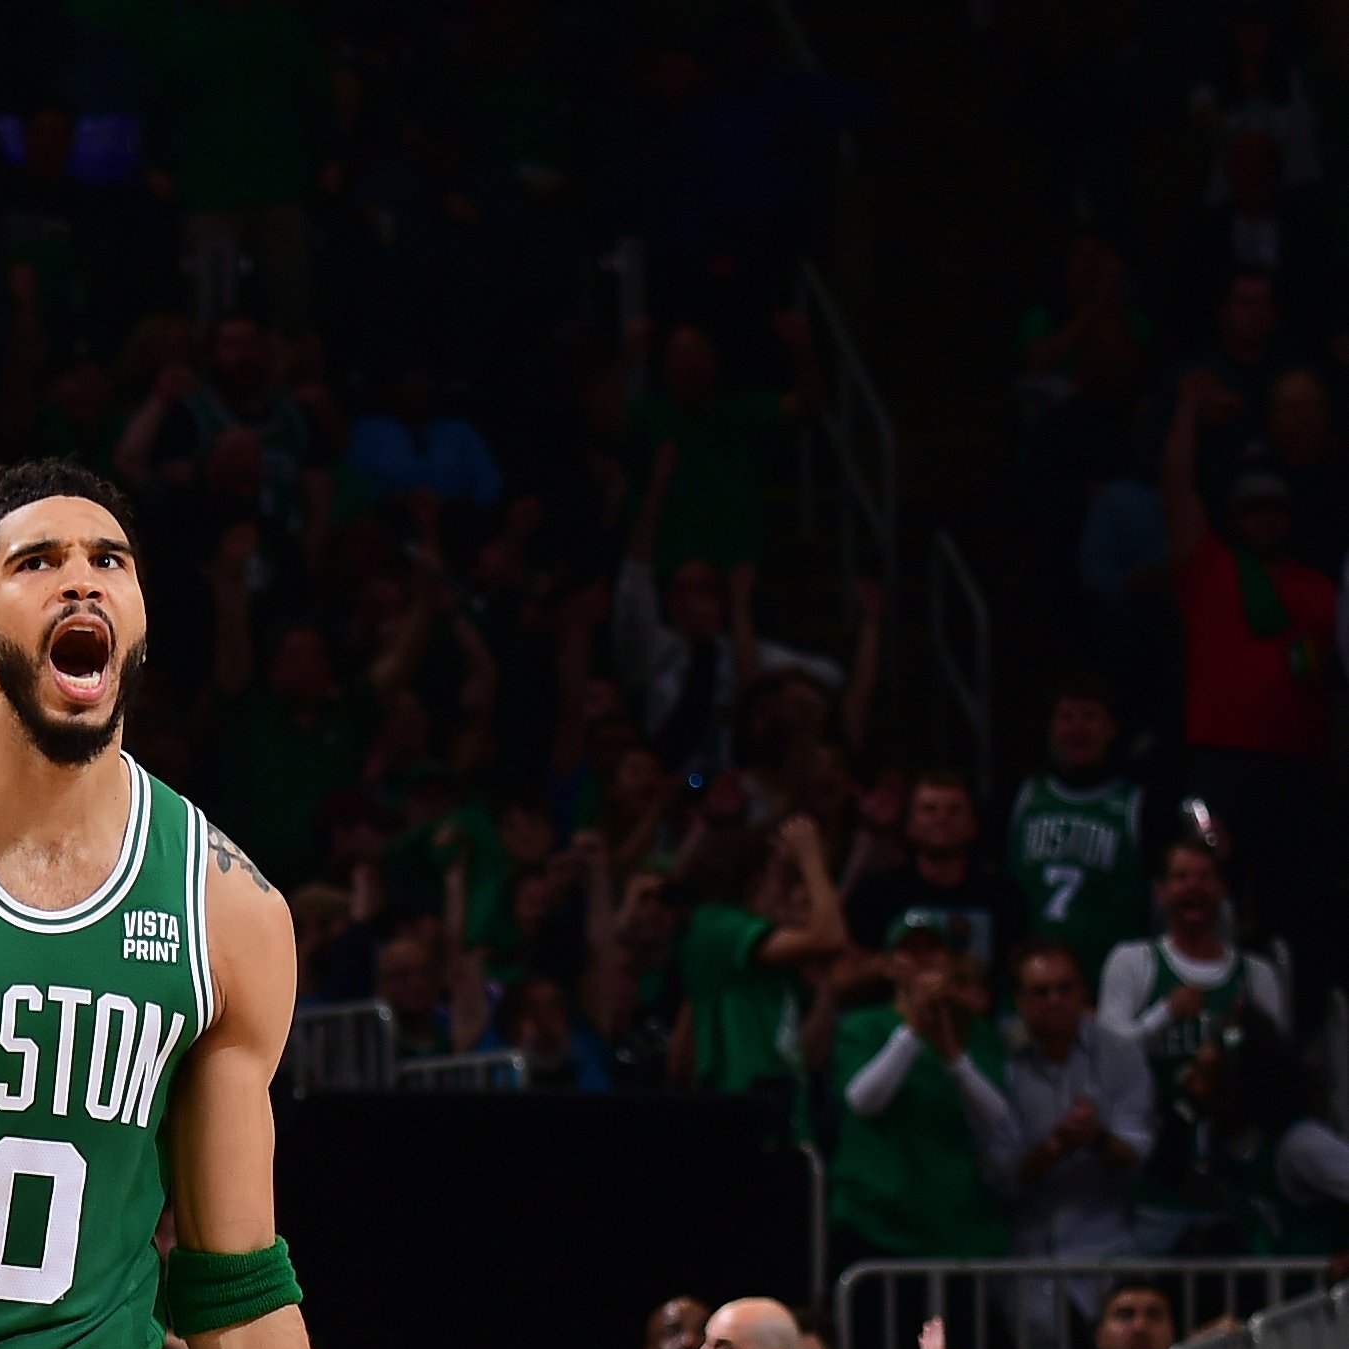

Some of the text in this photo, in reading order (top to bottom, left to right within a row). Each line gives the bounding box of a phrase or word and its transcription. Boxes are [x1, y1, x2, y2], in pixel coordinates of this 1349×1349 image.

[1042, 862, 1085, 922] 7
[123, 910, 180, 944] VISTA
[123, 938, 180, 964] PRINT
